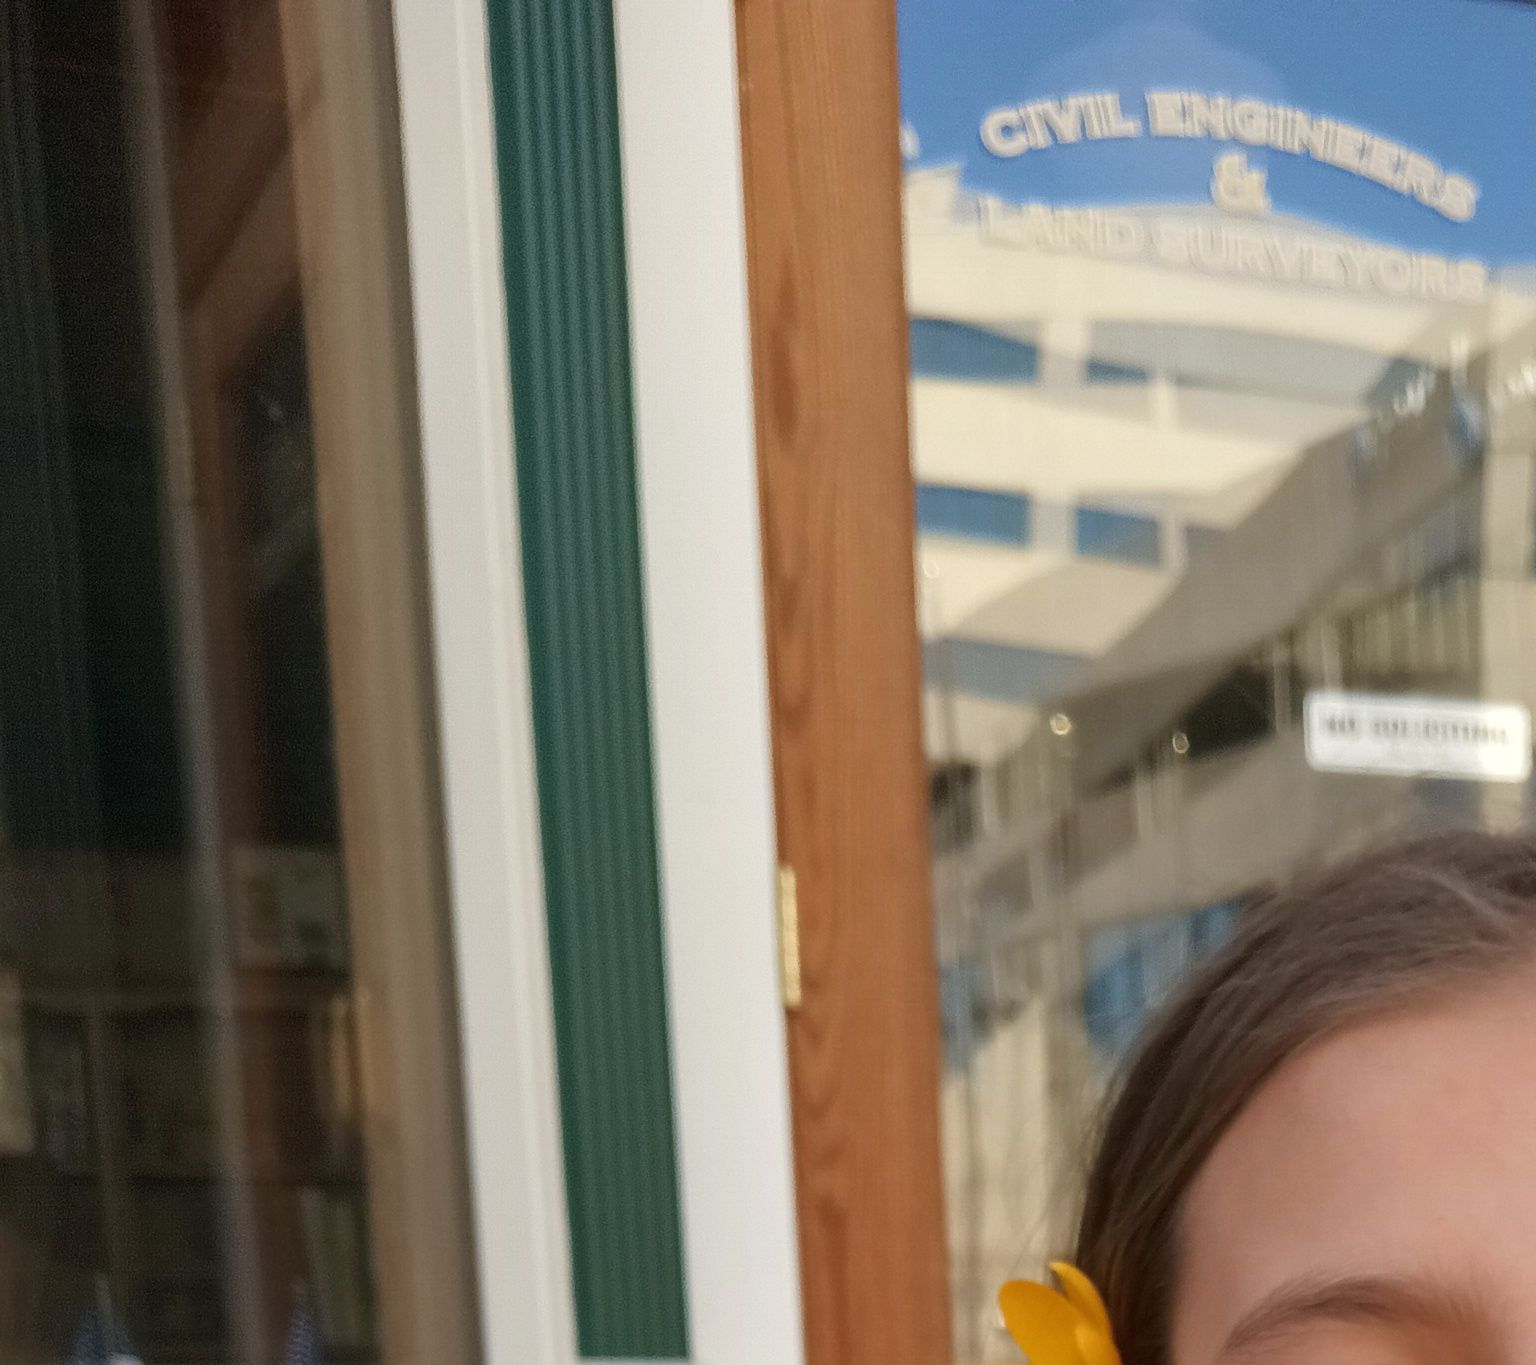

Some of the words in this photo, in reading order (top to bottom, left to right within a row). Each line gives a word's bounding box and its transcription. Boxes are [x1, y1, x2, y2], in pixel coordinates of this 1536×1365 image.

[981, 92, 1138, 157] CIVIL
[1146, 90, 1477, 222] ENGINEERS
[1212, 154, 1271, 218] &
[980, 198, 1143, 258] LAND
[1155, 221, 1488, 299] SURVEYORS
